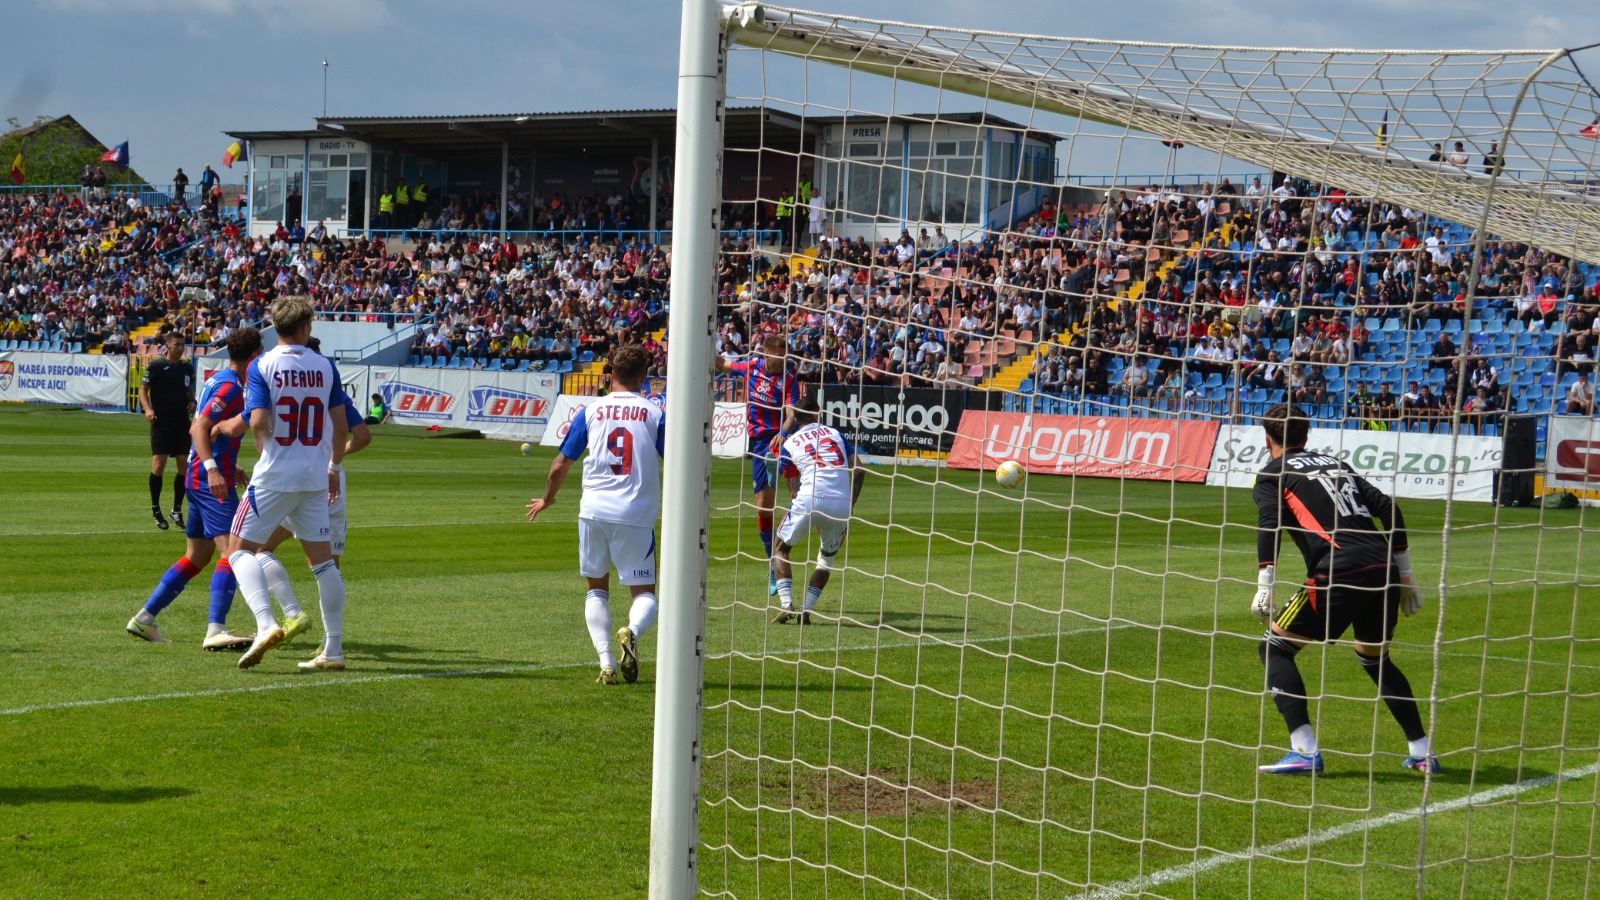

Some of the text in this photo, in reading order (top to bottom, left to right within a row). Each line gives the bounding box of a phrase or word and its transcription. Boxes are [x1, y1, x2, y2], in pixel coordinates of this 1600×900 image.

[853, 128, 881, 137] PRESA
[320, 142, 340, 150] RADIO
[347, 141, 355, 149] TV
[18, 364, 46, 375] MAREA
[273, 369, 324, 388] STEAUA
[397, 394, 453, 412] BMV
[486, 398, 547, 416] BMV
[275, 396, 324, 446] 30
[596, 405, 649, 422] STEAUA
[793, 427, 832, 447] STEAUA
[903, 434, 933, 445] fiecare
[986, 415, 1170, 472] utopium
[607, 427, 633, 475] 9
[804, 438, 845, 468] 13
